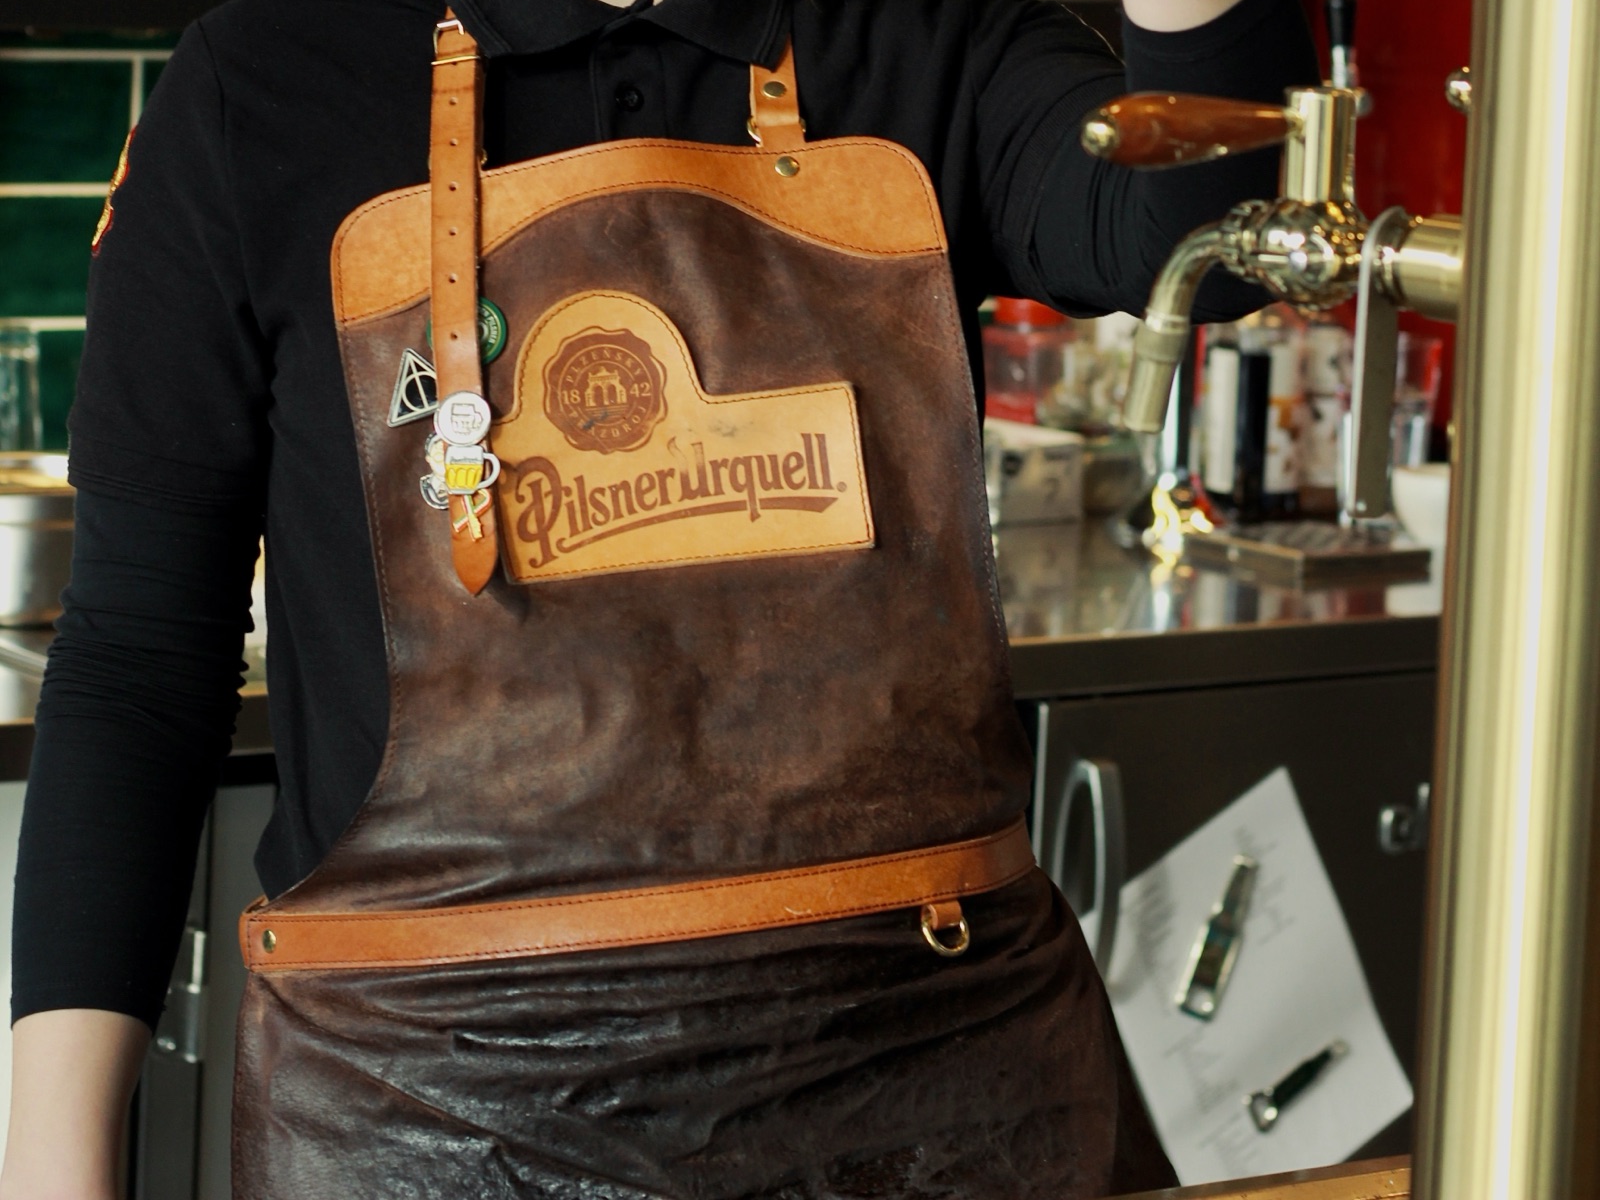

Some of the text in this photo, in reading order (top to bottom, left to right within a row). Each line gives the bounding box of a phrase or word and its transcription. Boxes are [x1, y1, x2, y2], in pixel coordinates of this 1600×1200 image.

[562, 381, 651, 404] 18 42
[515, 456, 676, 569] Pilsner
